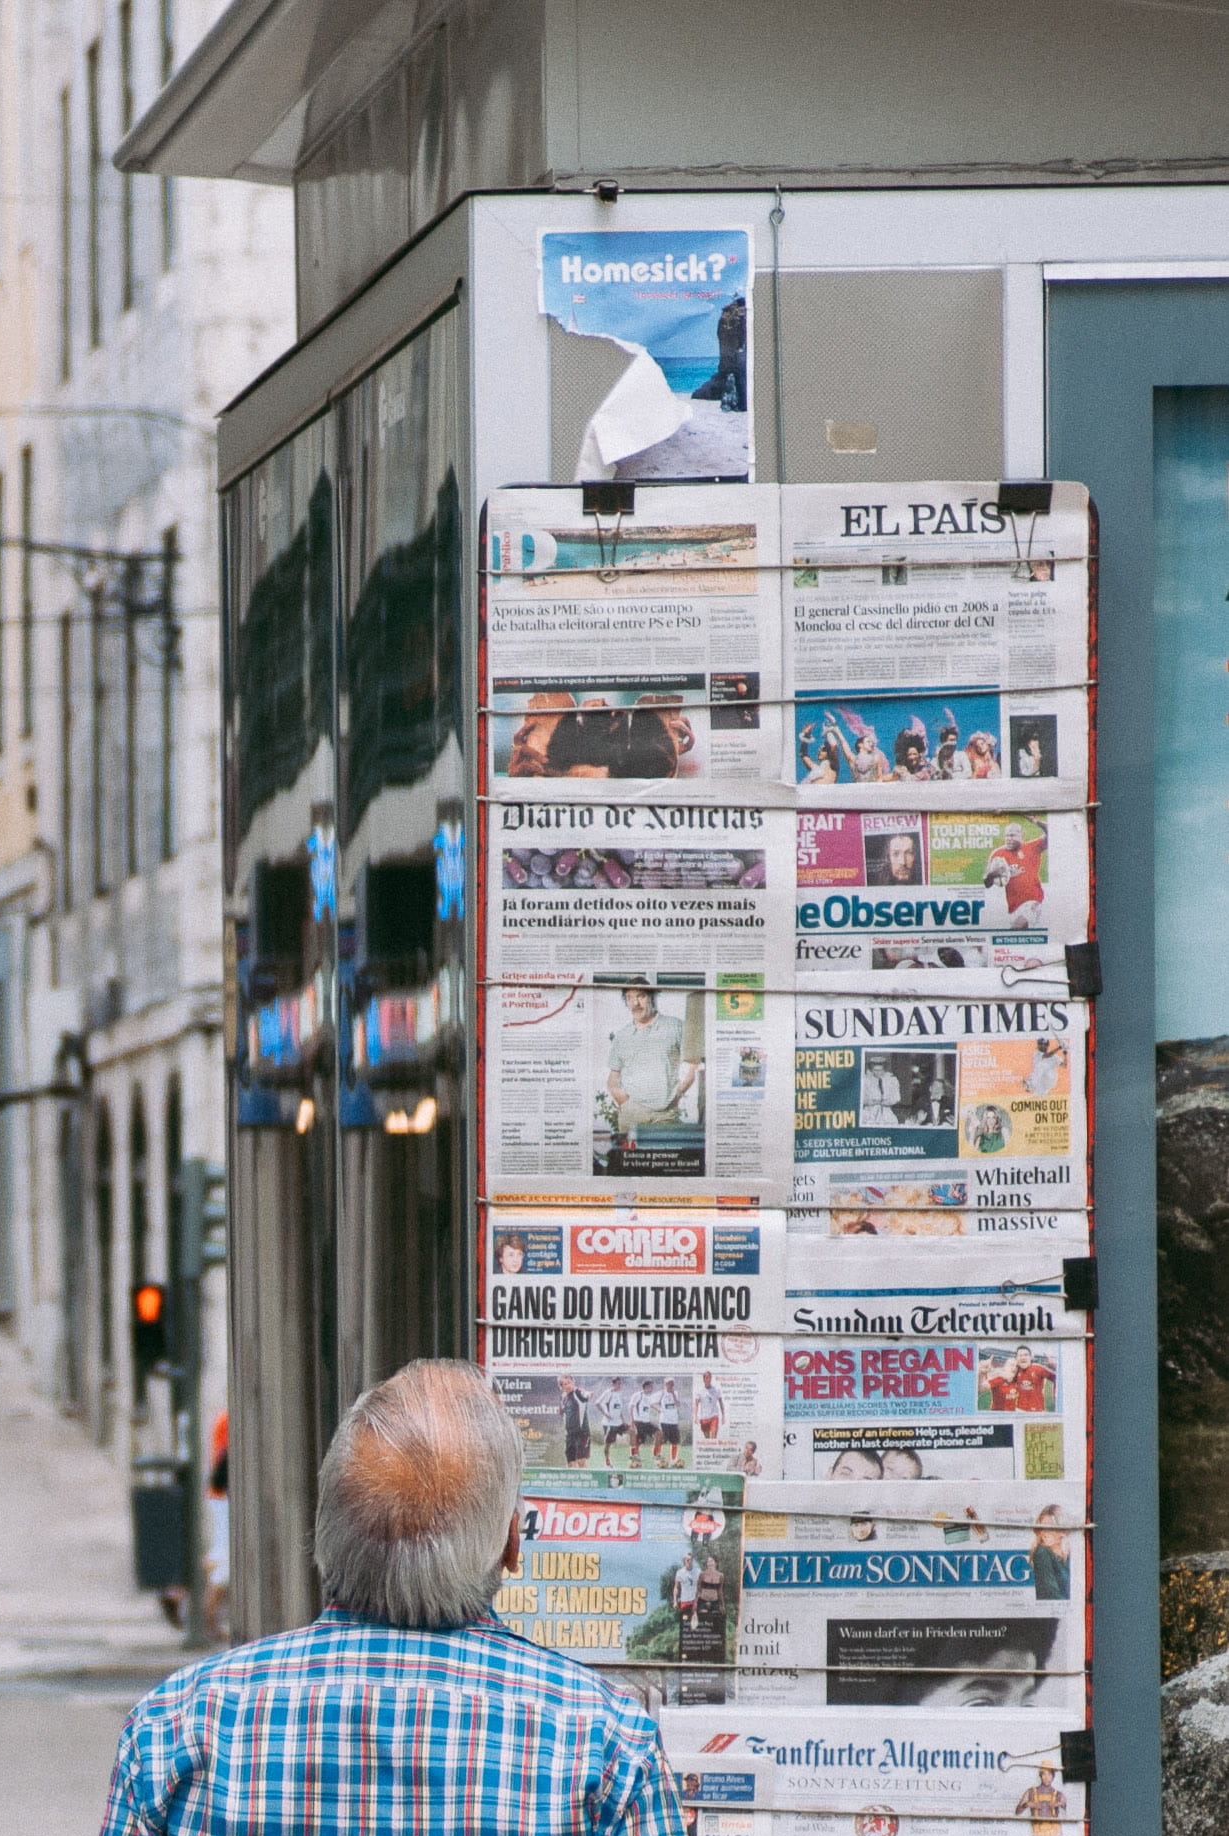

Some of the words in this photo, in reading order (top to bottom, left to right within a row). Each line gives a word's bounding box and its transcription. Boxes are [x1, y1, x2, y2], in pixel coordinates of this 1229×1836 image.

[560, 253, 727, 284] Homesick?
[840, 504, 900, 537] EL
[908, 498, 1007, 536] PAÍS
[491, 605, 535, 620] Apoios
[552, 603, 582, 616] PME
[583, 603, 605, 615] são
[616, 604, 648, 615] novo
[650, 602, 693, 618] campo
[794, 605, 806, 618] El
[808, 604, 850, 619] general
[853, 602, 910, 617] Cassinello
[912, 602, 941, 617] pidió
[961, 601, 990, 613] 2008
[491, 621, 508, 632] de
[509, 620, 557, 632] batalha
[558, 618, 611, 631] eleitoral
[612, 618, 647, 630] entre
[648, 616, 665, 629] PS
[676, 616, 702, 628] PSD
[794, 620, 842, 633] Moncloa
[845, 619, 856, 631] el
[885, 618, 903, 631] del
[905, 617, 950, 630] director
[953, 616, 971, 628] del
[974, 615, 996, 628] CNI
[604, 804, 636, 830] de
[863, 814, 920, 830] REVIEW
[931, 824, 968, 838] TOUR
[968, 823, 1001, 837] ENDS
[931, 837, 951, 851] ON
[963, 835, 995, 850] HIGH
[502, 898, 518, 912] Já
[520, 897, 571, 911] foram
[573, 896, 633, 911] detidos
[636, 897, 669, 911] oito
[671, 899, 715, 911] vezes
[717, 897, 757, 911] mais
[823, 895, 986, 929] Observer
[502, 914, 606, 929] incendiários
[608, 916, 638, 931] que
[641, 917, 663, 928] no
[665, 917, 697, 928] ano
[698, 914, 766, 931] passado
[796, 939, 863, 960] freeze
[805, 1007, 951, 1040] SUNDAY
[957, 1001, 1070, 1035] TIMES
[1010, 1101, 1047, 1113] COMING
[1047, 1099, 1068, 1112] OUT
[795, 1112, 856, 1131] BOTTOM
[1034, 1113, 1050, 1124] ON
[1051, 1112, 1069, 1124] TOP
[834, 1136, 892, 1147] REVELATIONS
[812, 1148, 854, 1158] CULTURE
[854, 1146, 926, 1157] INTERNATIONAL
[975, 1166, 1071, 1186] Whitehall
[976, 1190, 1032, 1210] plans
[976, 1213, 1059, 1233] massive
[576, 1227, 699, 1256] CORREIO
[492, 1285, 557, 1321] GANG
[563, 1285, 594, 1321] DO
[600, 1285, 751, 1321] MULTIBANCO
[793, 1307, 905, 1338] Sunday
[910, 1305, 1055, 1335] Telegraph
[492, 1324, 593, 1359] DIRIGIDO
[599, 1324, 630, 1358] DA
[636, 1324, 720, 1358] CADEIA
[860, 1347, 975, 1373] REGAIN
[784, 1374, 857, 1400] HEIR
[862, 1373, 951, 1399] PRIDE
[889, 1401, 908, 1409] TWO
[813, 1428, 852, 1439] Victims
[852, 1428, 863, 1438] of
[864, 1429, 877, 1438] an
[878, 1427, 915, 1438] inferno
[915, 1427, 939, 1439] Help
[954, 1425, 995, 1437] pleaded
[813, 1439, 850, 1450] mother
[851, 1439, 861, 1449] in
[861, 1438, 880, 1449] last
[881, 1437, 933, 1450] desperate
[932, 1437, 964, 1449] phone
[965, 1435, 983, 1447] call
[531, 1552, 601, 1581] LUXOS
[829, 1563, 864, 1580] am
[865, 1555, 1032, 1585] SONNTAG
[545, 1586, 648, 1615] FAMOSOS
[531, 1619, 623, 1649] ALGARVE
[744, 1618, 791, 1635] droht
[838, 1627, 873, 1639] Wann
[873, 1626, 900, 1639] darf
[898, 1630, 911, 1639] er
[911, 1626, 924, 1638] in
[925, 1626, 968, 1639] Frieden
[969, 1625, 1009, 1638] ruhen?
[754, 1640, 781, 1656] mit
[878, 1738, 1008, 1774] Allgemeine
[703, 1774, 725, 1784] Bruno
[725, 1774, 746, 1784] Alves
[787, 1777, 963, 1793] SONNTAGSZEITUNG
[702, 1785, 721, 1794] quer
